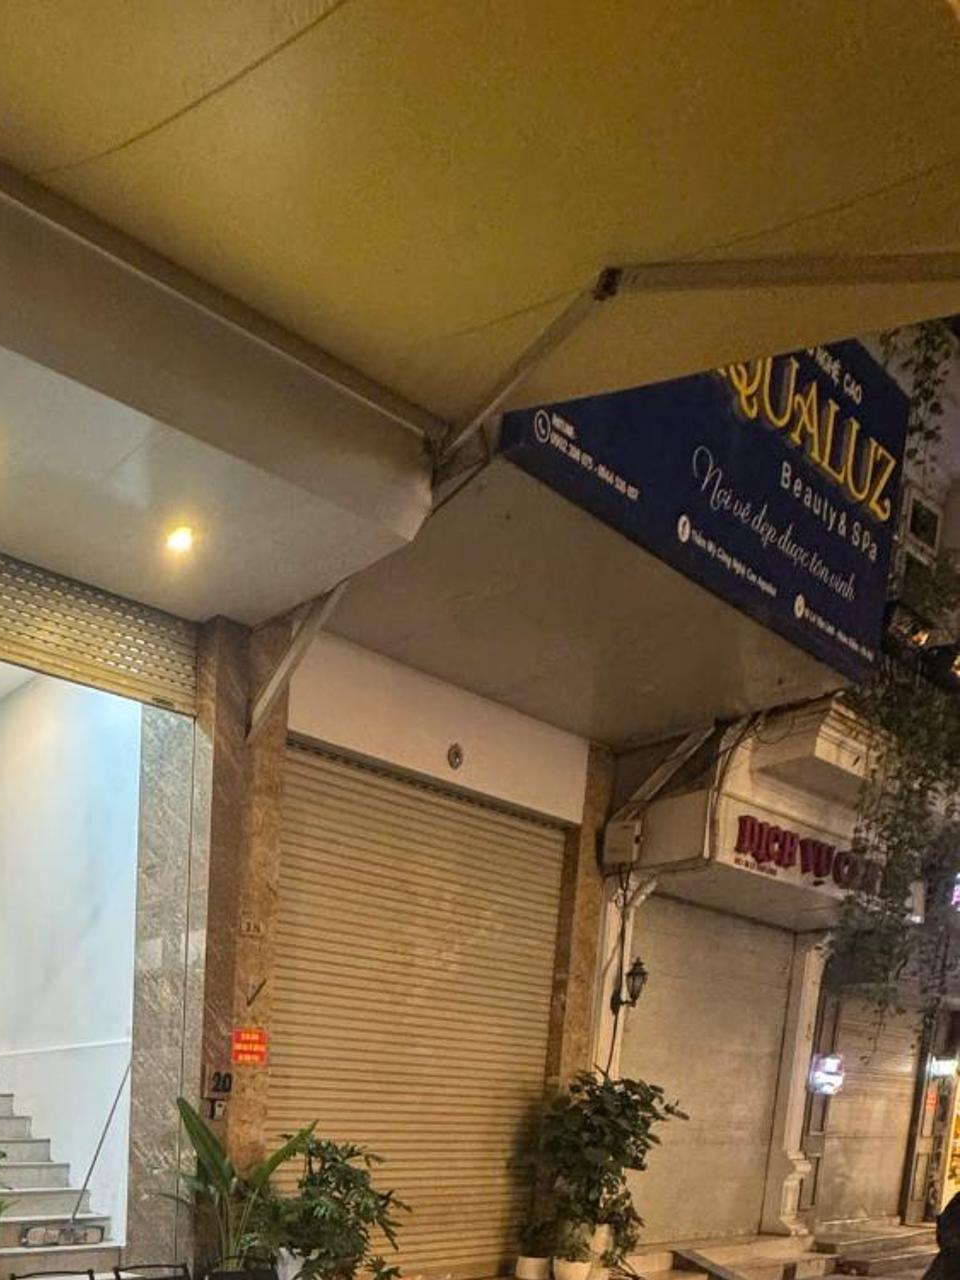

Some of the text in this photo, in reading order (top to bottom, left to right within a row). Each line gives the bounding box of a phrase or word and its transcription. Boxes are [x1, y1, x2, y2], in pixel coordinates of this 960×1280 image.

[717, 356, 897, 522] QUALUZ
[780, 461, 879, 562] Beauty & Spa
[211, 1071, 233, 1093] 20
